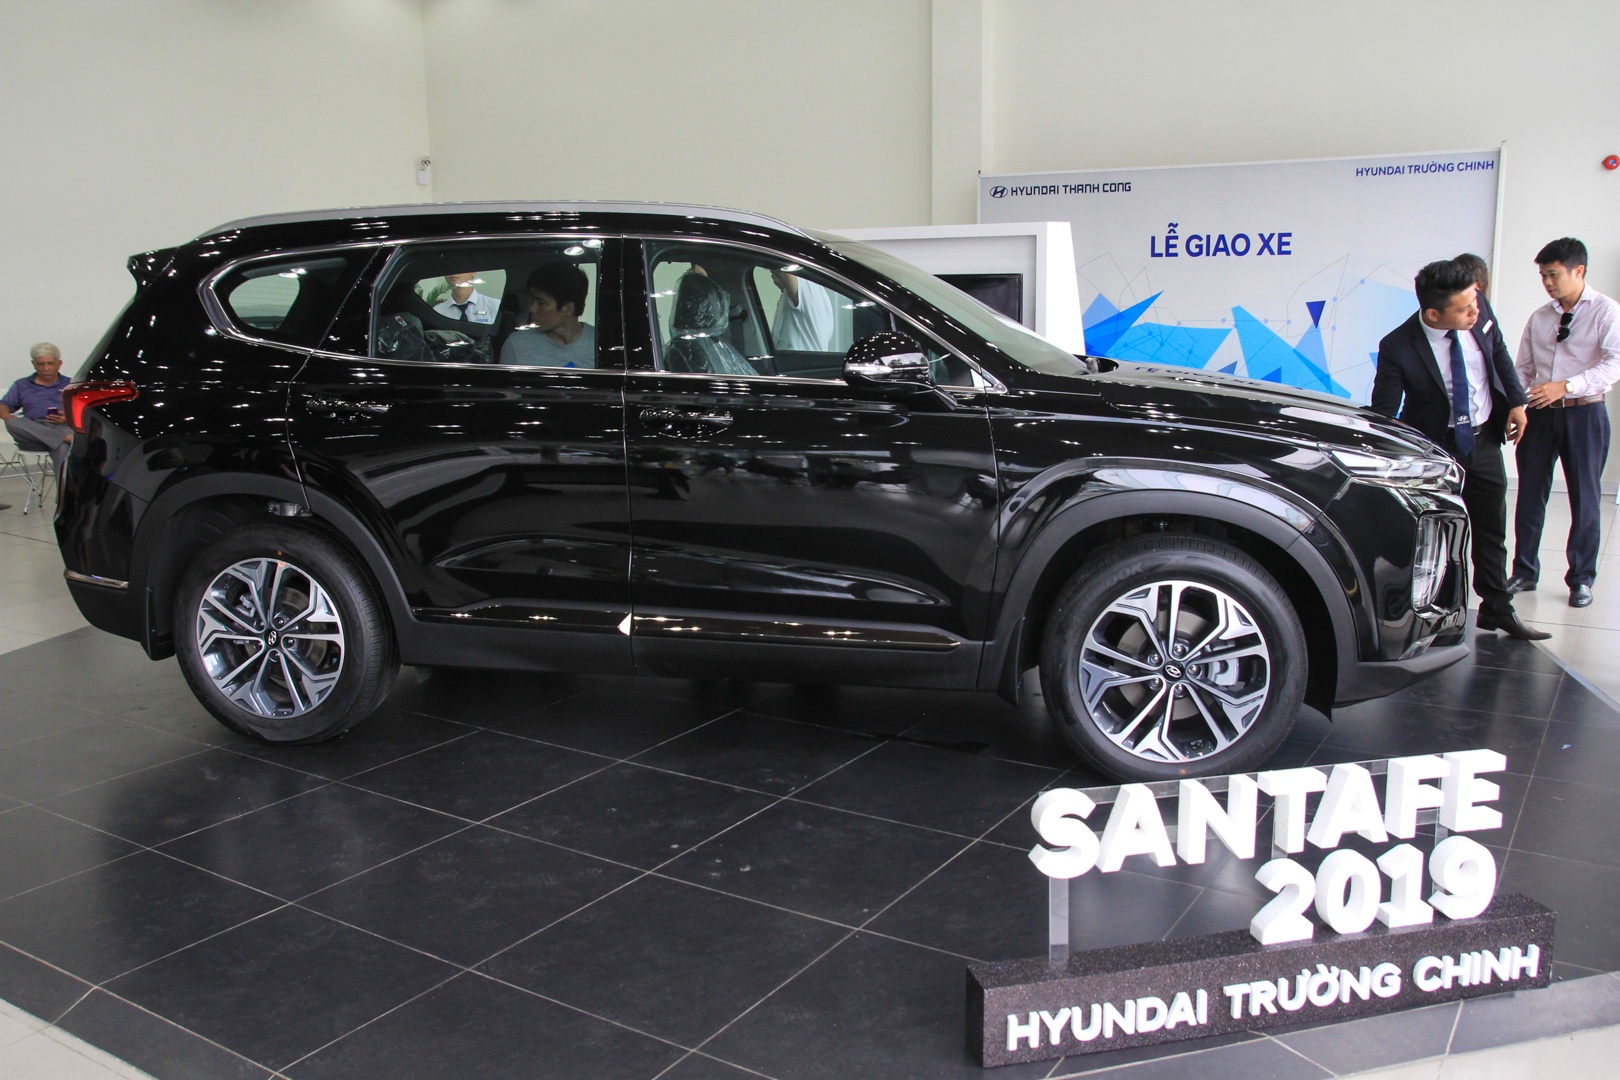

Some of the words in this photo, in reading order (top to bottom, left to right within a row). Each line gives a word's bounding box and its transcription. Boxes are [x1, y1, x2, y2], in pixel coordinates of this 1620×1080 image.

[1354, 165, 1405, 177] HYUNDAI
[1407, 161, 1455, 174] TRƯỜNG
[1456, 160, 1495, 172] CHINH
[1010, 185, 1060, 196] HYUNDAI
[1062, 183, 1100, 194] THANH
[1102, 182, 1132, 193] CONG
[1150, 222, 1179, 258] LỄ
[1185, 233, 1251, 257] GIAO
[1256, 232, 1293, 256] XE
[1250, 835, 1498, 946] 2019
[1007, 988, 1208, 1051] HYUNDAI
[1223, 963, 1402, 1019] TRƯỜNG
[1412, 943, 1540, 992] CHINH
